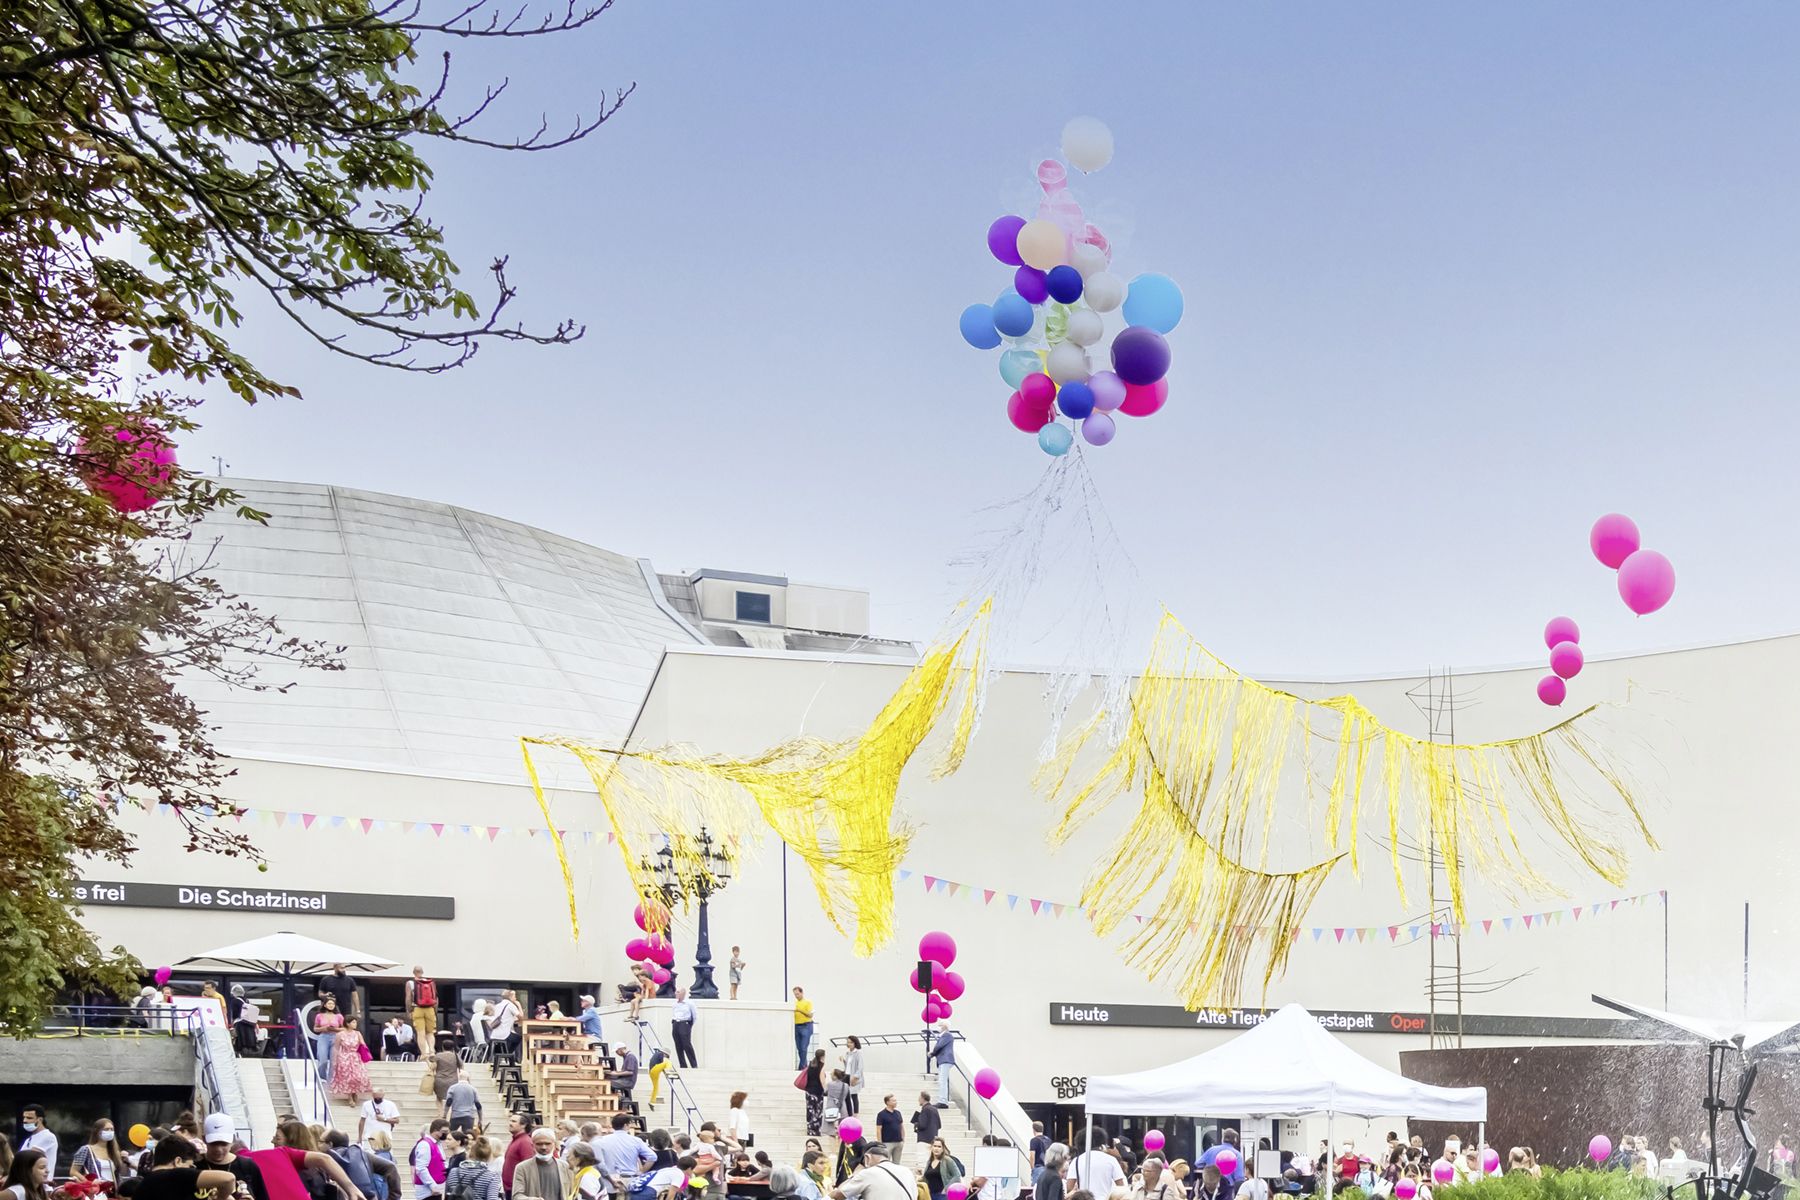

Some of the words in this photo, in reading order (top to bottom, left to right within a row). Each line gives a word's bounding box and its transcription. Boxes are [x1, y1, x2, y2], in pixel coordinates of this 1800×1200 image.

[91, 884, 125, 901] frei
[178, 887, 212, 905] Die
[216, 888, 327, 910] Schatzinsel
[1061, 1005, 1109, 1022] Heute
[1196, 1009, 1227, 1025] Alte
[1230, 1010, 1267, 1026] Tiere
[1390, 1014, 1426, 1031] Oper
[1051, 1076, 1087, 1088] GROS
[1057, 1087, 1086, 1099] BÜH
